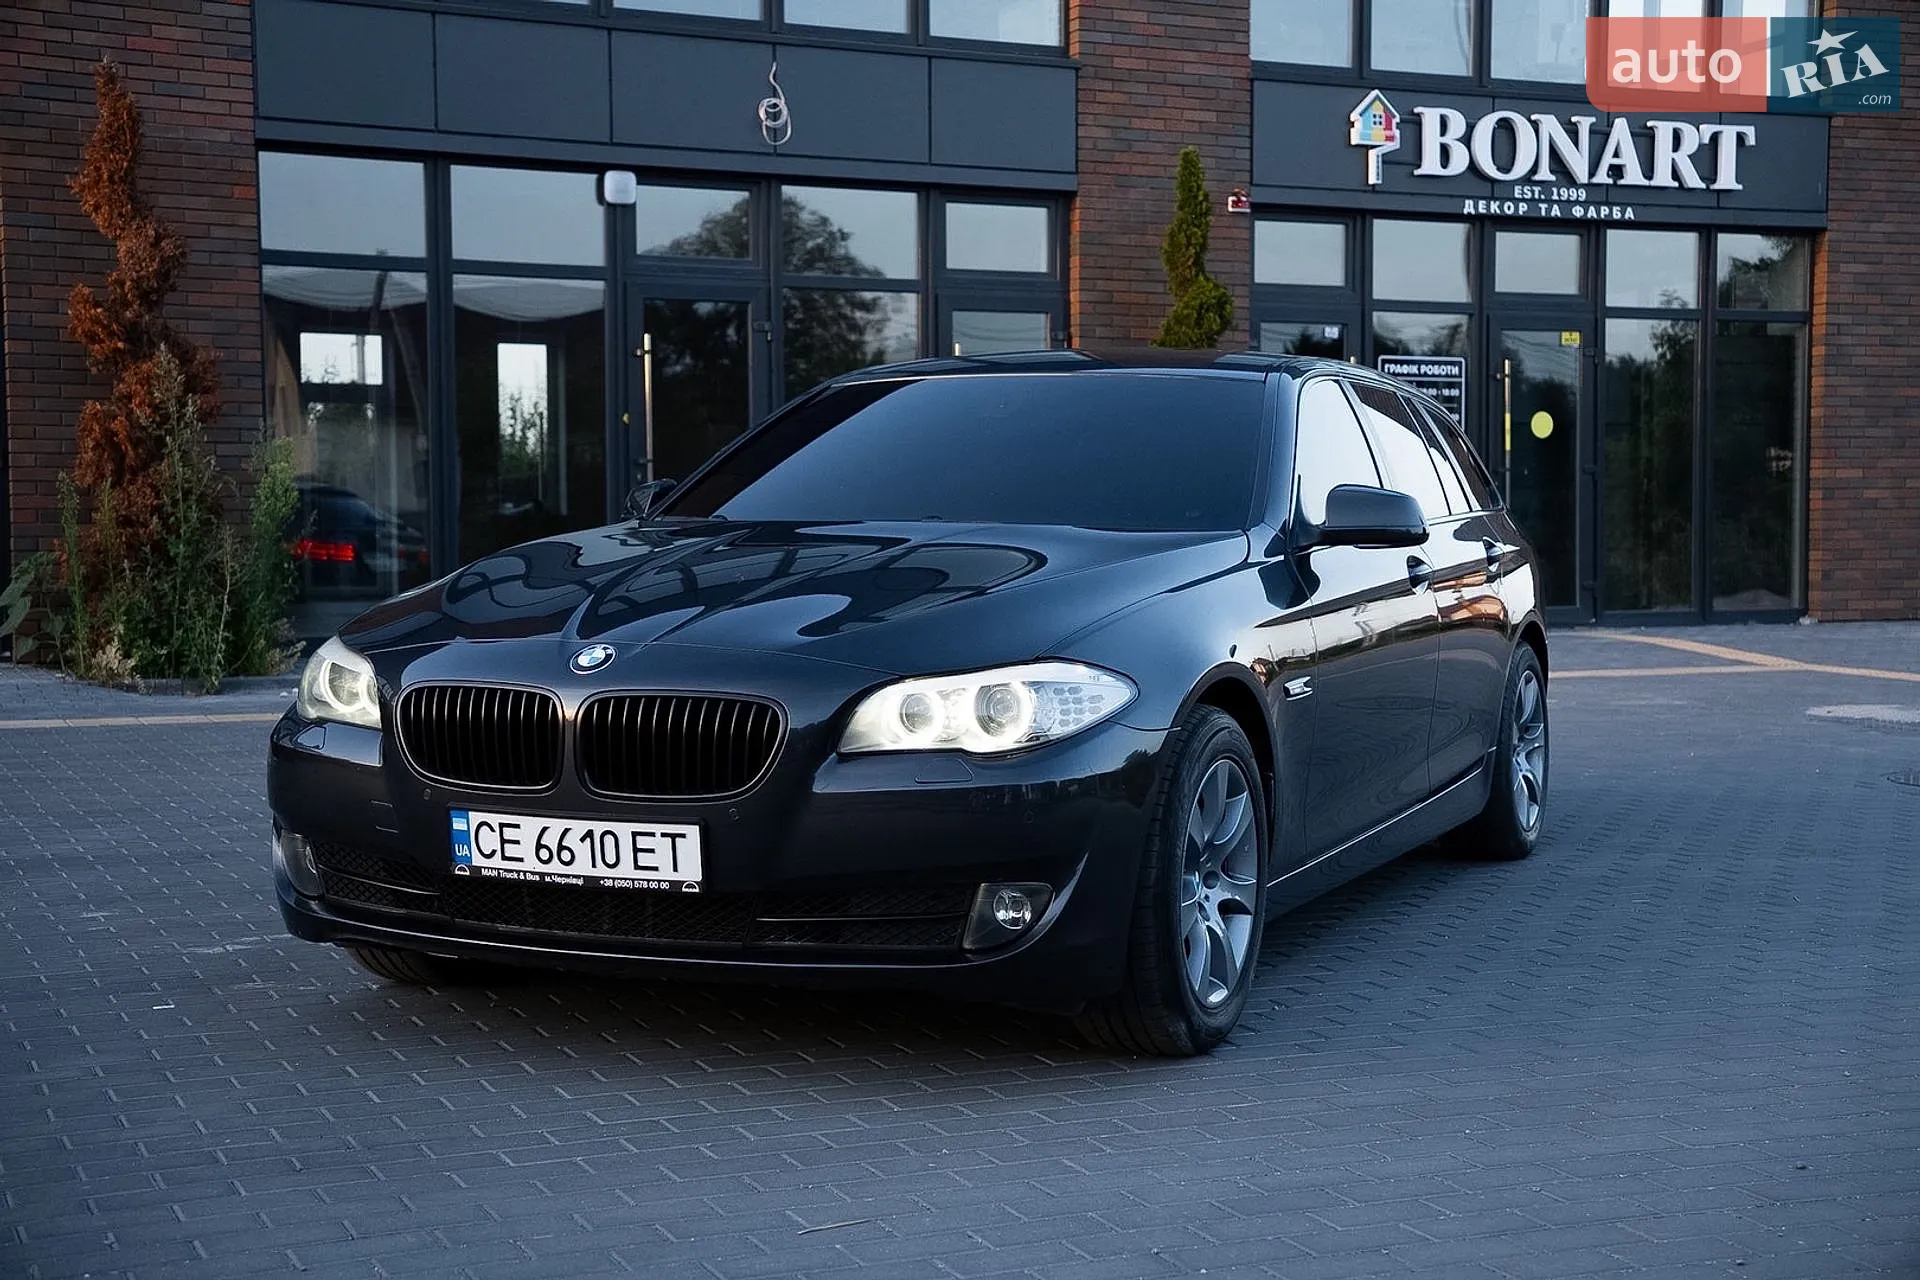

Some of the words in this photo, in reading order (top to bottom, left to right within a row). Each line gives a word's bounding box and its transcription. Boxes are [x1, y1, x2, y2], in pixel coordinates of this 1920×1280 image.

[1413, 106, 1757, 191] BONART
[1513, 185, 1546, 200] EST.
[1551, 187, 1587, 201] 1999
[1463, 199, 1529, 216] ДЕКОР
[1538, 203, 1561, 217] ТА
[1571, 205, 1635, 220] ФАРБА
[1384, 363, 1419, 375] ГРАФІК
[1420, 364, 1459, 376] РОБОТИ
[454, 844, 471, 857] UA
[474, 820, 525, 862] CE
[534, 826, 620, 869] 6610
[631, 830, 687, 873] ET
[499, 869, 518, 880] Truck
[526, 872, 540, 881] Bus
